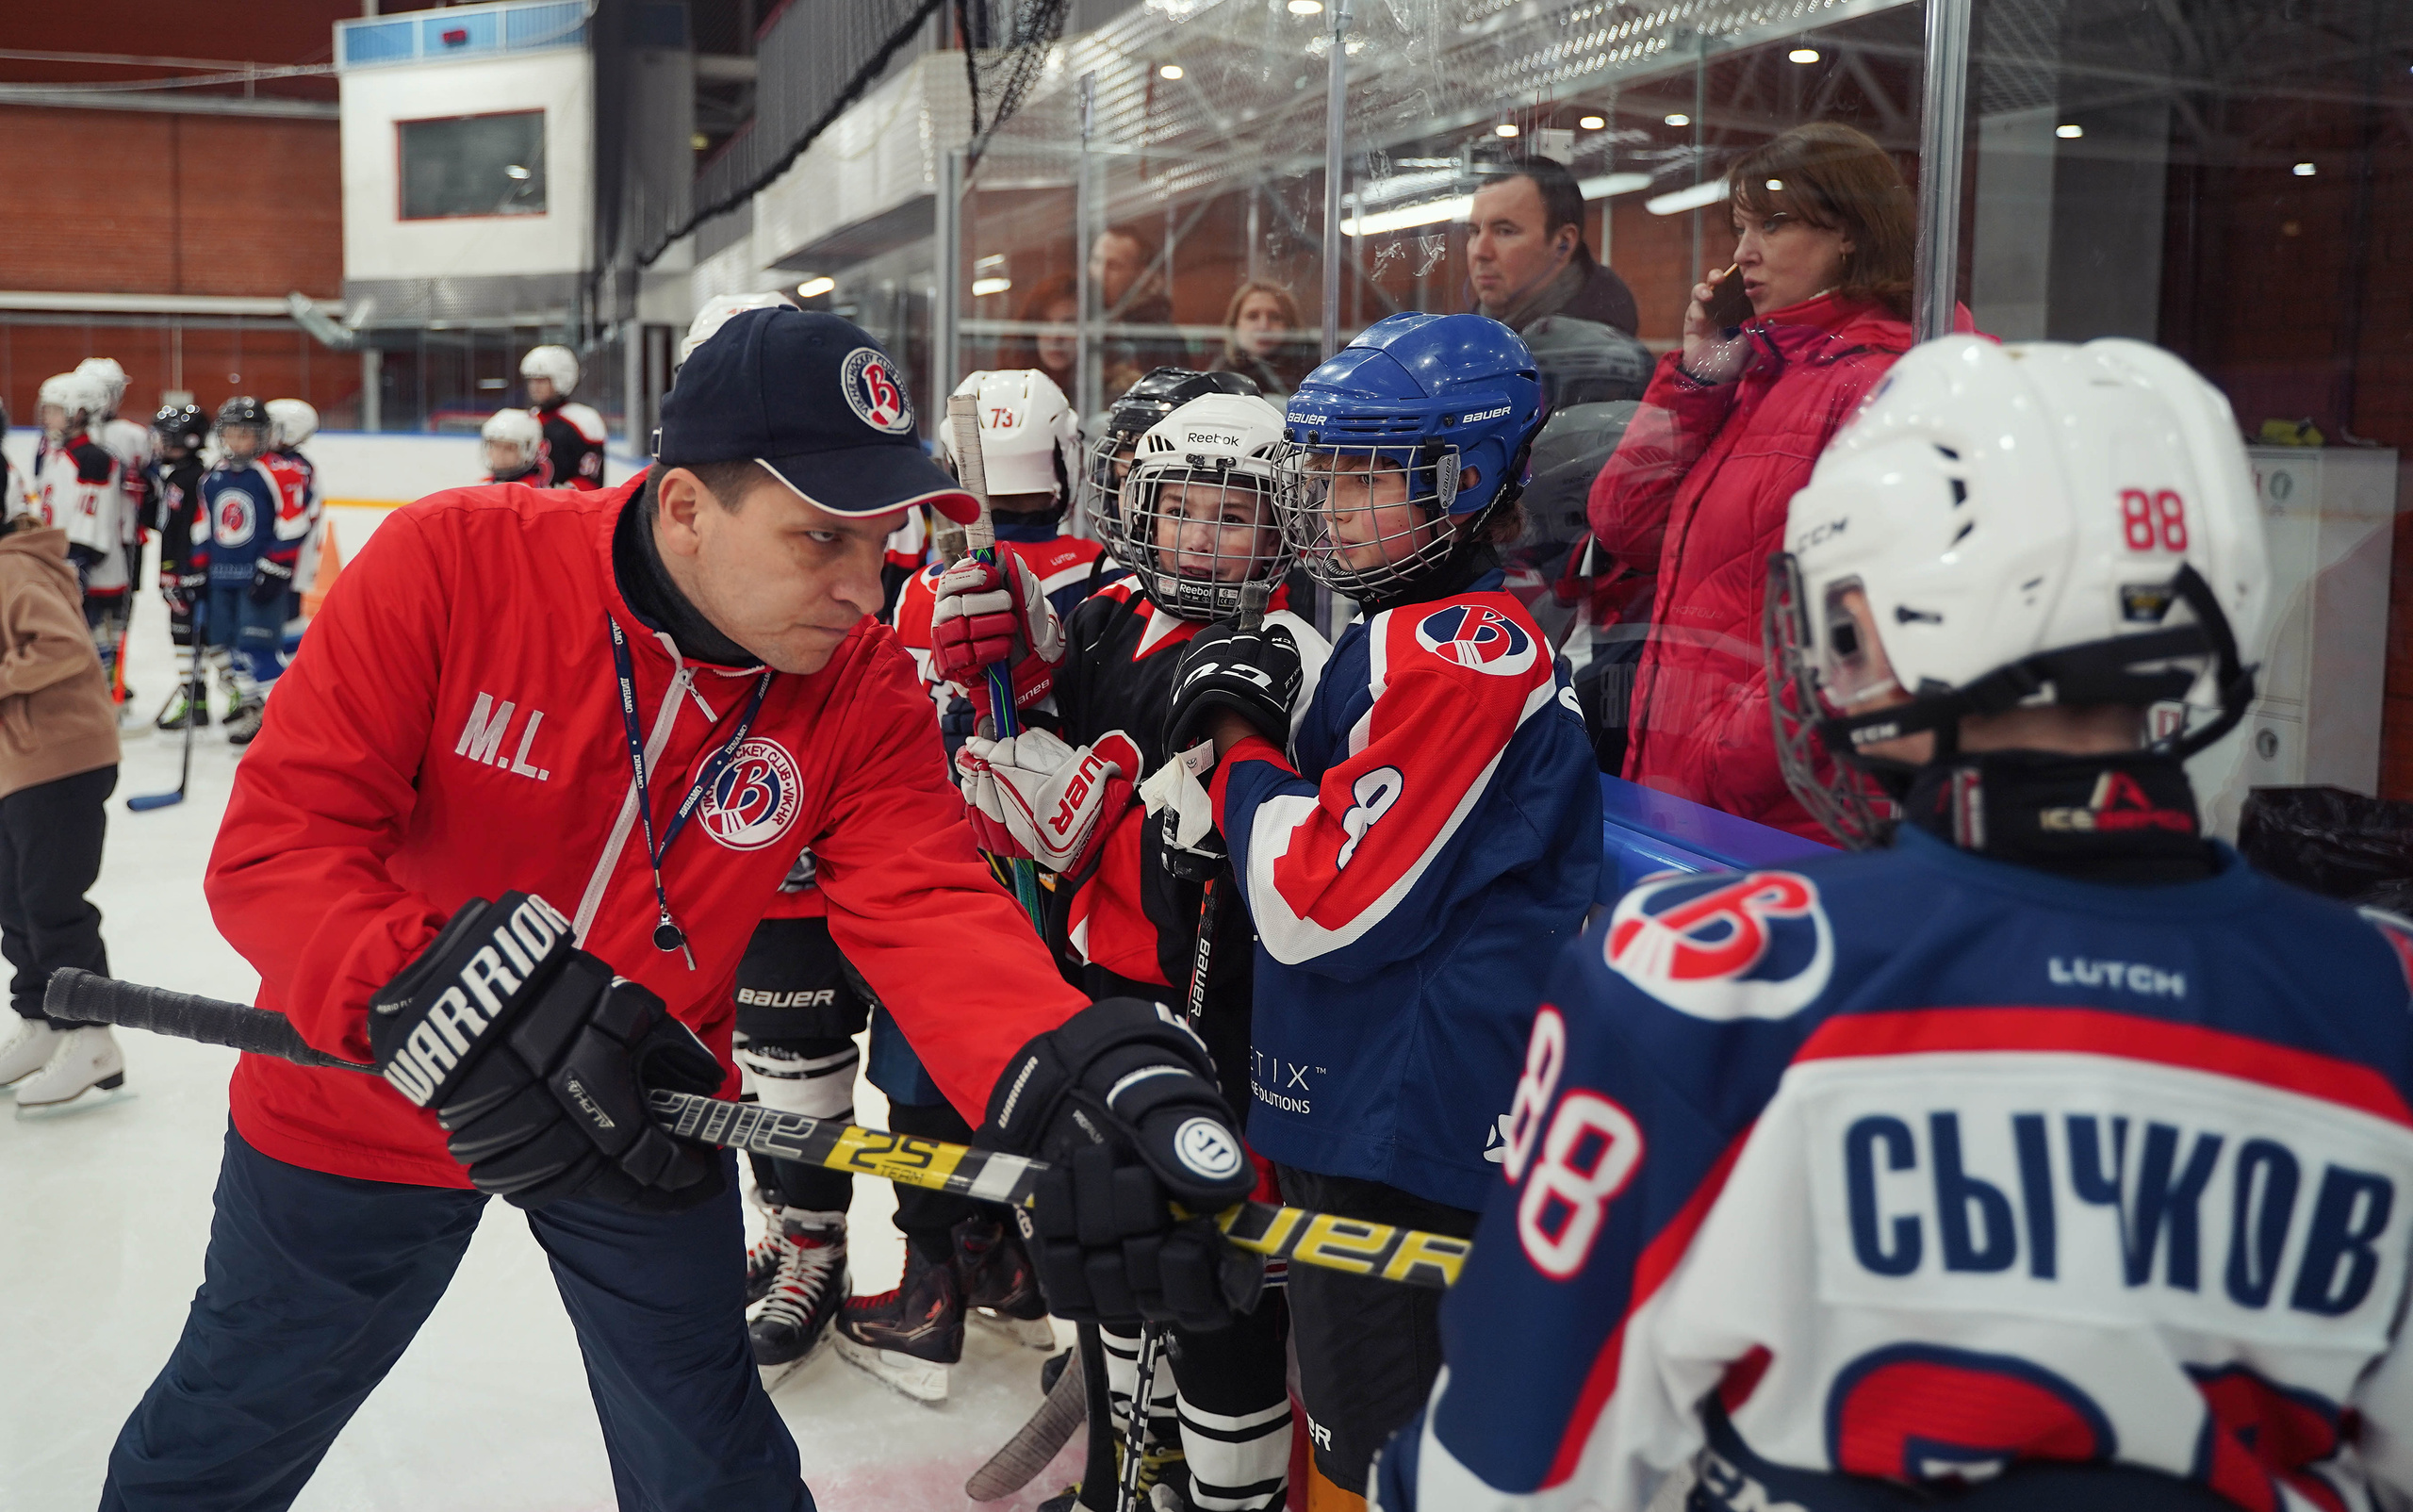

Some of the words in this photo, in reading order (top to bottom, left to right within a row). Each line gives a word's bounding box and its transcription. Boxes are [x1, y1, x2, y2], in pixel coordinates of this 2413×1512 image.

[849, 353, 874, 378] HOCKEY
[991, 407, 1013, 429] 73
[1187, 432, 1239, 448] Reebok
[2119, 488, 2188, 552] 88
[454, 690, 550, 781] M.L.
[766, 750, 792, 782] CLUB
[771, 786, 796, 827] VIKHR
[2048, 955, 2188, 999] LUTCH
[384, 893, 573, 1108] WARRIOR
[878, 1164, 926, 1184] TEAM
[1843, 1109, 2397, 1320] СЫЧКОВ
